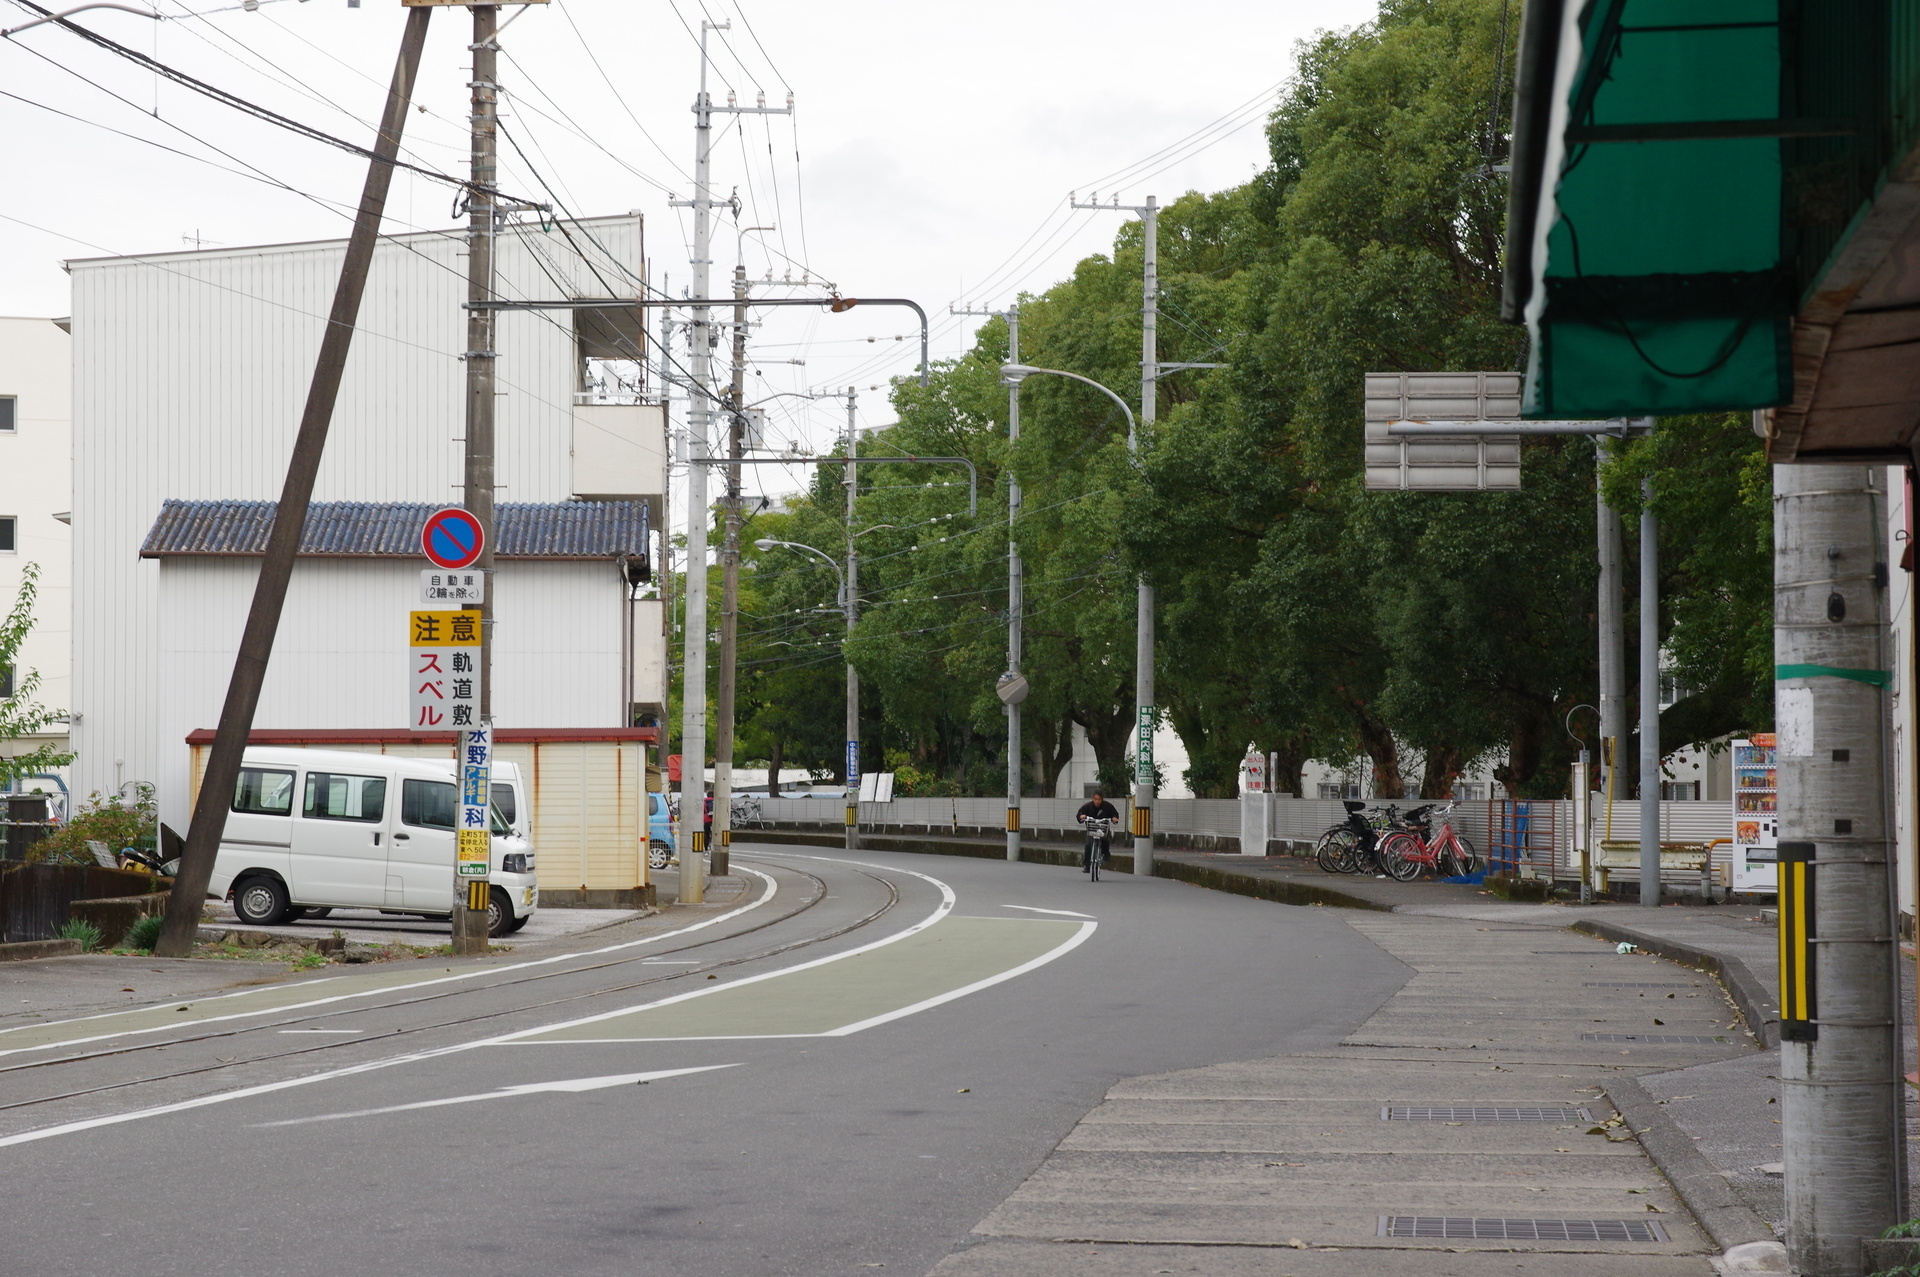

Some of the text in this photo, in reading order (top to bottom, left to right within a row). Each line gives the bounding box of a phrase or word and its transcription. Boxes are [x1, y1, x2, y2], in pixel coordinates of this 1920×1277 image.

[431, 575, 474, 586] 自動車
[415, 615, 476, 642] 注意
[418, 653, 444, 726] スベル
[452, 651, 473, 726] 軌道敷
[467, 724, 487, 765] 水野
[465, 767, 477, 804] アレルギー
[465, 808, 485, 828] 科
